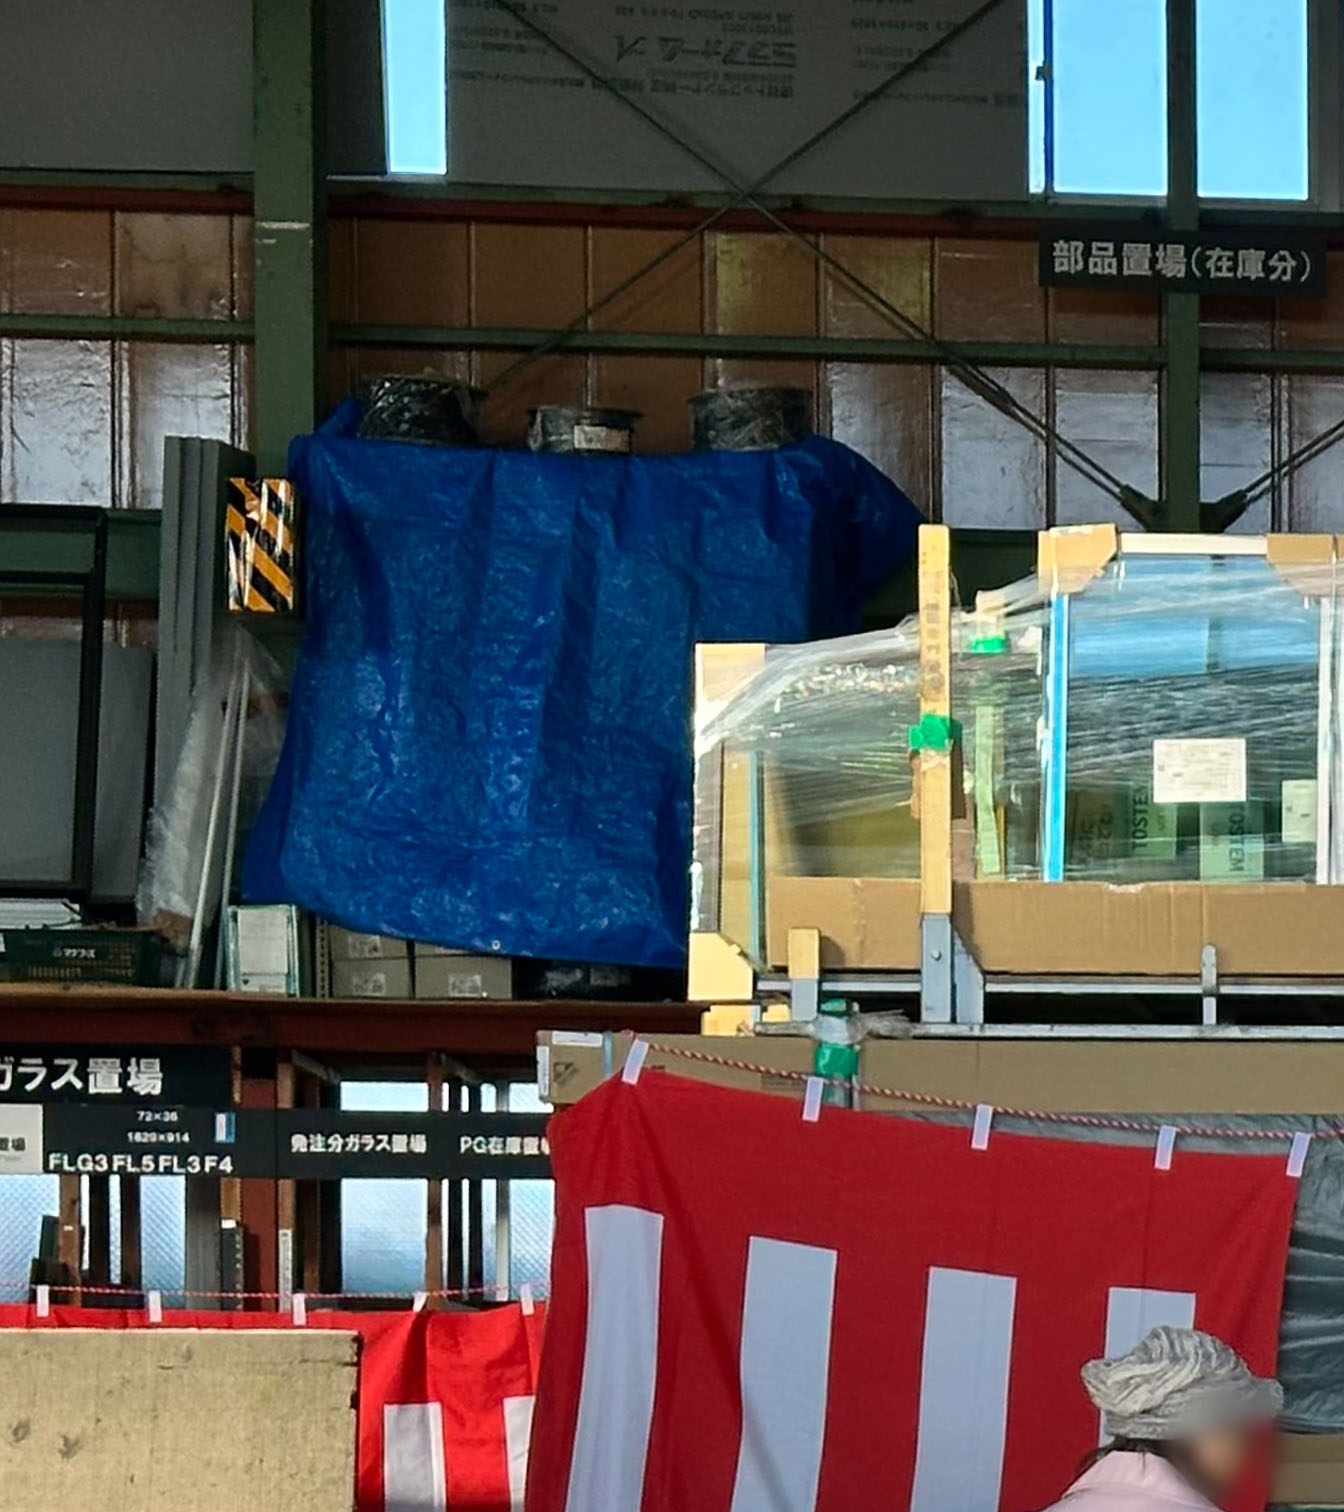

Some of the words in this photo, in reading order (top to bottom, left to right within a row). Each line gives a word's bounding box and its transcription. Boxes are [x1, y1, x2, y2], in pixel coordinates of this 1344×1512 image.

[1052, 239, 1312, 283] 部品置場(在庫分)
[49, 1152, 109, 1173] FLG3
[112, 1154, 156, 1173] FL5
[158, 1155, 201, 1174] FL3
[204, 1155, 234, 1174] F4
